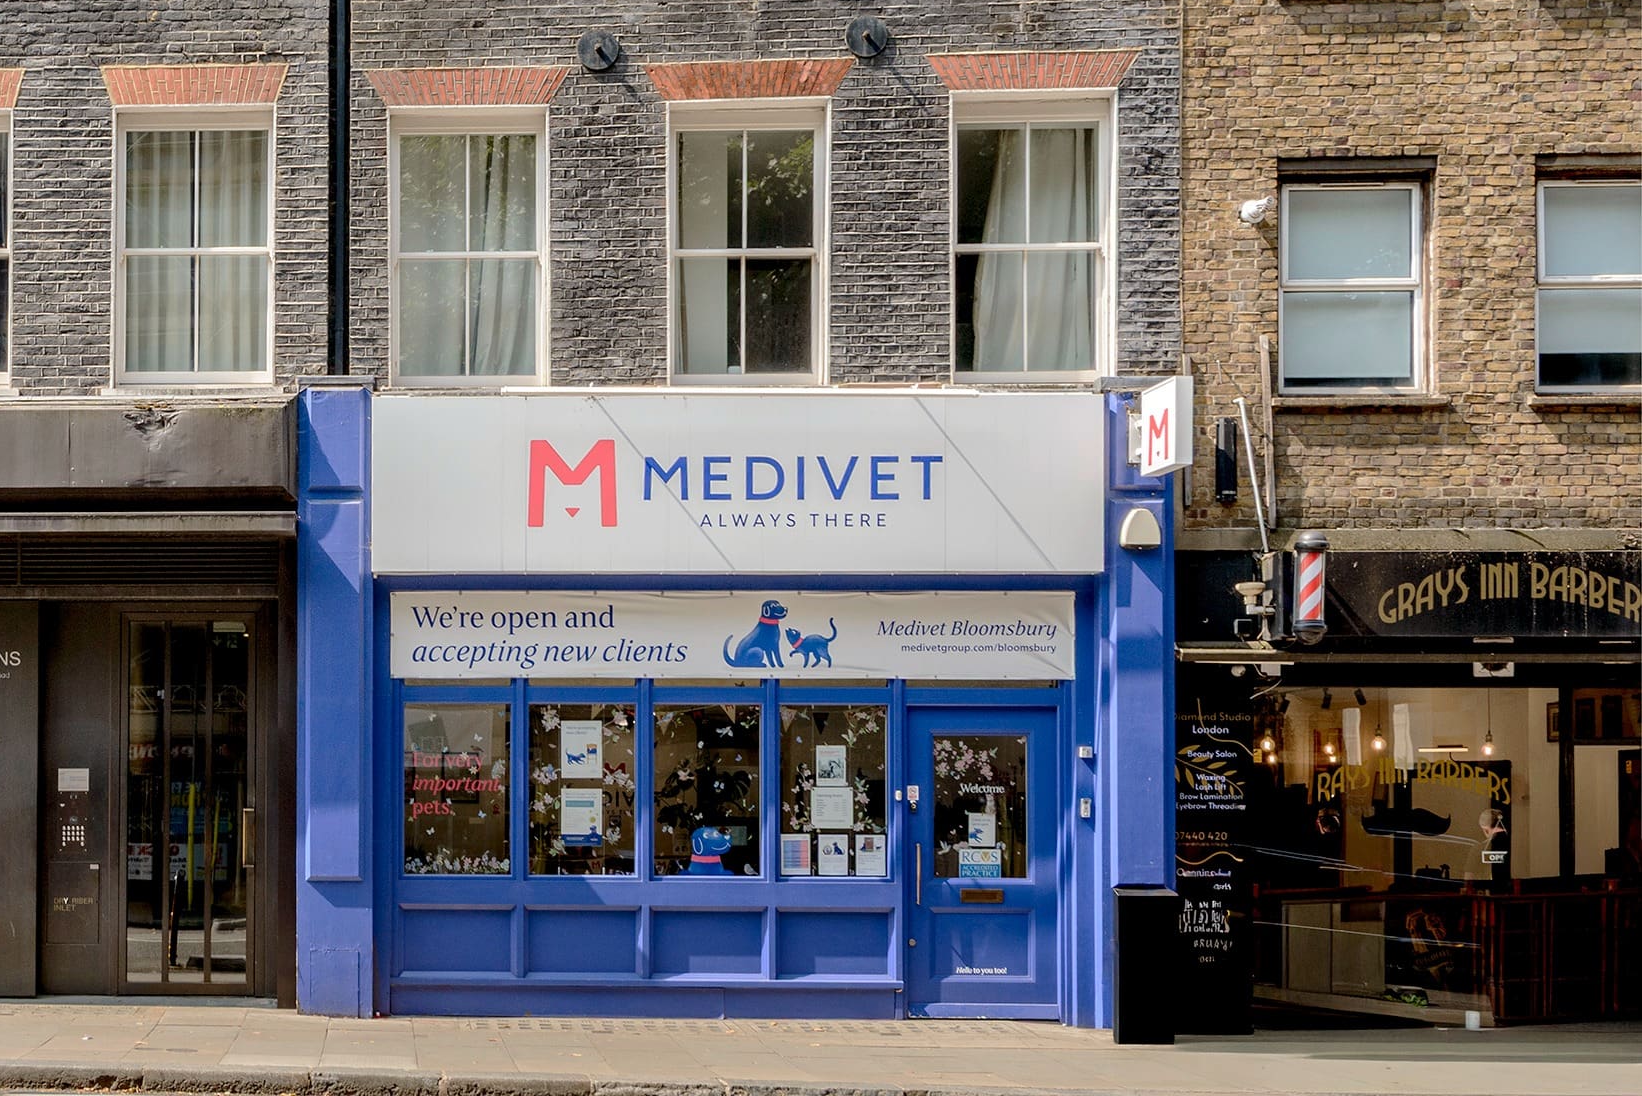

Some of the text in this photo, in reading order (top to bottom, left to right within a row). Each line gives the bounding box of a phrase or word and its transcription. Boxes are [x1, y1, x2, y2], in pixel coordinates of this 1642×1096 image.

[1148, 408, 1169, 466] M
[527, 439, 618, 528] M
[642, 456, 943, 501] MEDIVET
[699, 513, 887, 528] ALWAYS THERE
[1378, 565, 1470, 624] GRAYS
[1480, 561, 1519, 600] INN
[411, 604, 615, 635] We're open and
[877, 620, 1057, 641] Medivet Bloomsbury
[412, 638, 689, 669] accepting new clients
[901, 643, 1056, 654] medivetgroup.com/bloomsbury
[1219, 711, 1251, 721] Studio
[1192, 725, 1230, 734] London
[412, 751, 484, 770] For very
[1187, 750, 1238, 759] Beauty Salon
[412, 775, 501, 796] important
[1196, 773, 1226, 782] Waxing
[959, 782, 1005, 794] Welcome
[1179, 792, 1243, 800] Brow Lamination
[412, 800, 455, 819] pets.
[1207, 831, 1228, 841] 420
[980, 967, 994, 975] you
